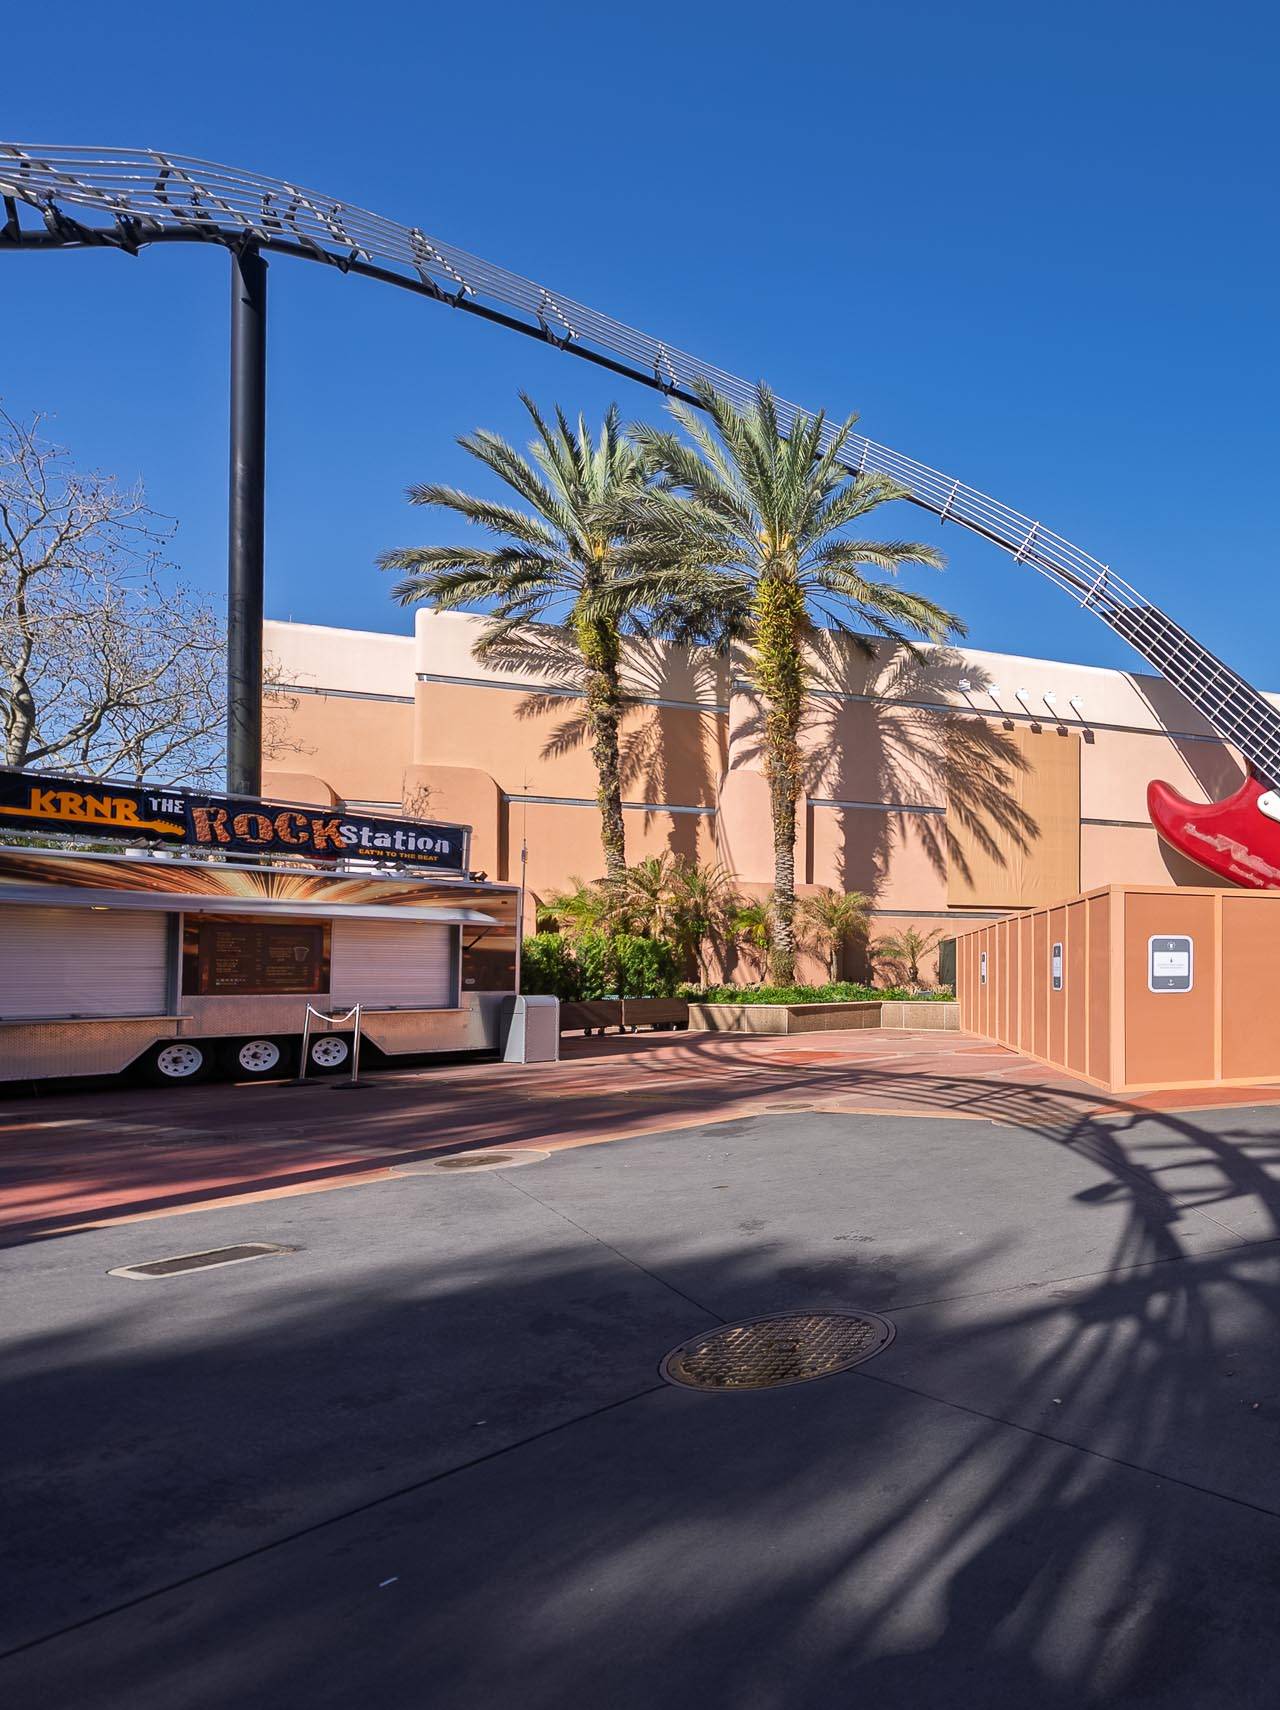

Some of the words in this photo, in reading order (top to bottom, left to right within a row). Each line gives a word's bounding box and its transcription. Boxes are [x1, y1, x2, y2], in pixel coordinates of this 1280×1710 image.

[31, 787, 140, 821] KRNR
[149, 797, 185, 814] THE
[191, 807, 347, 849] ROCK
[339, 825, 450, 854] Station
